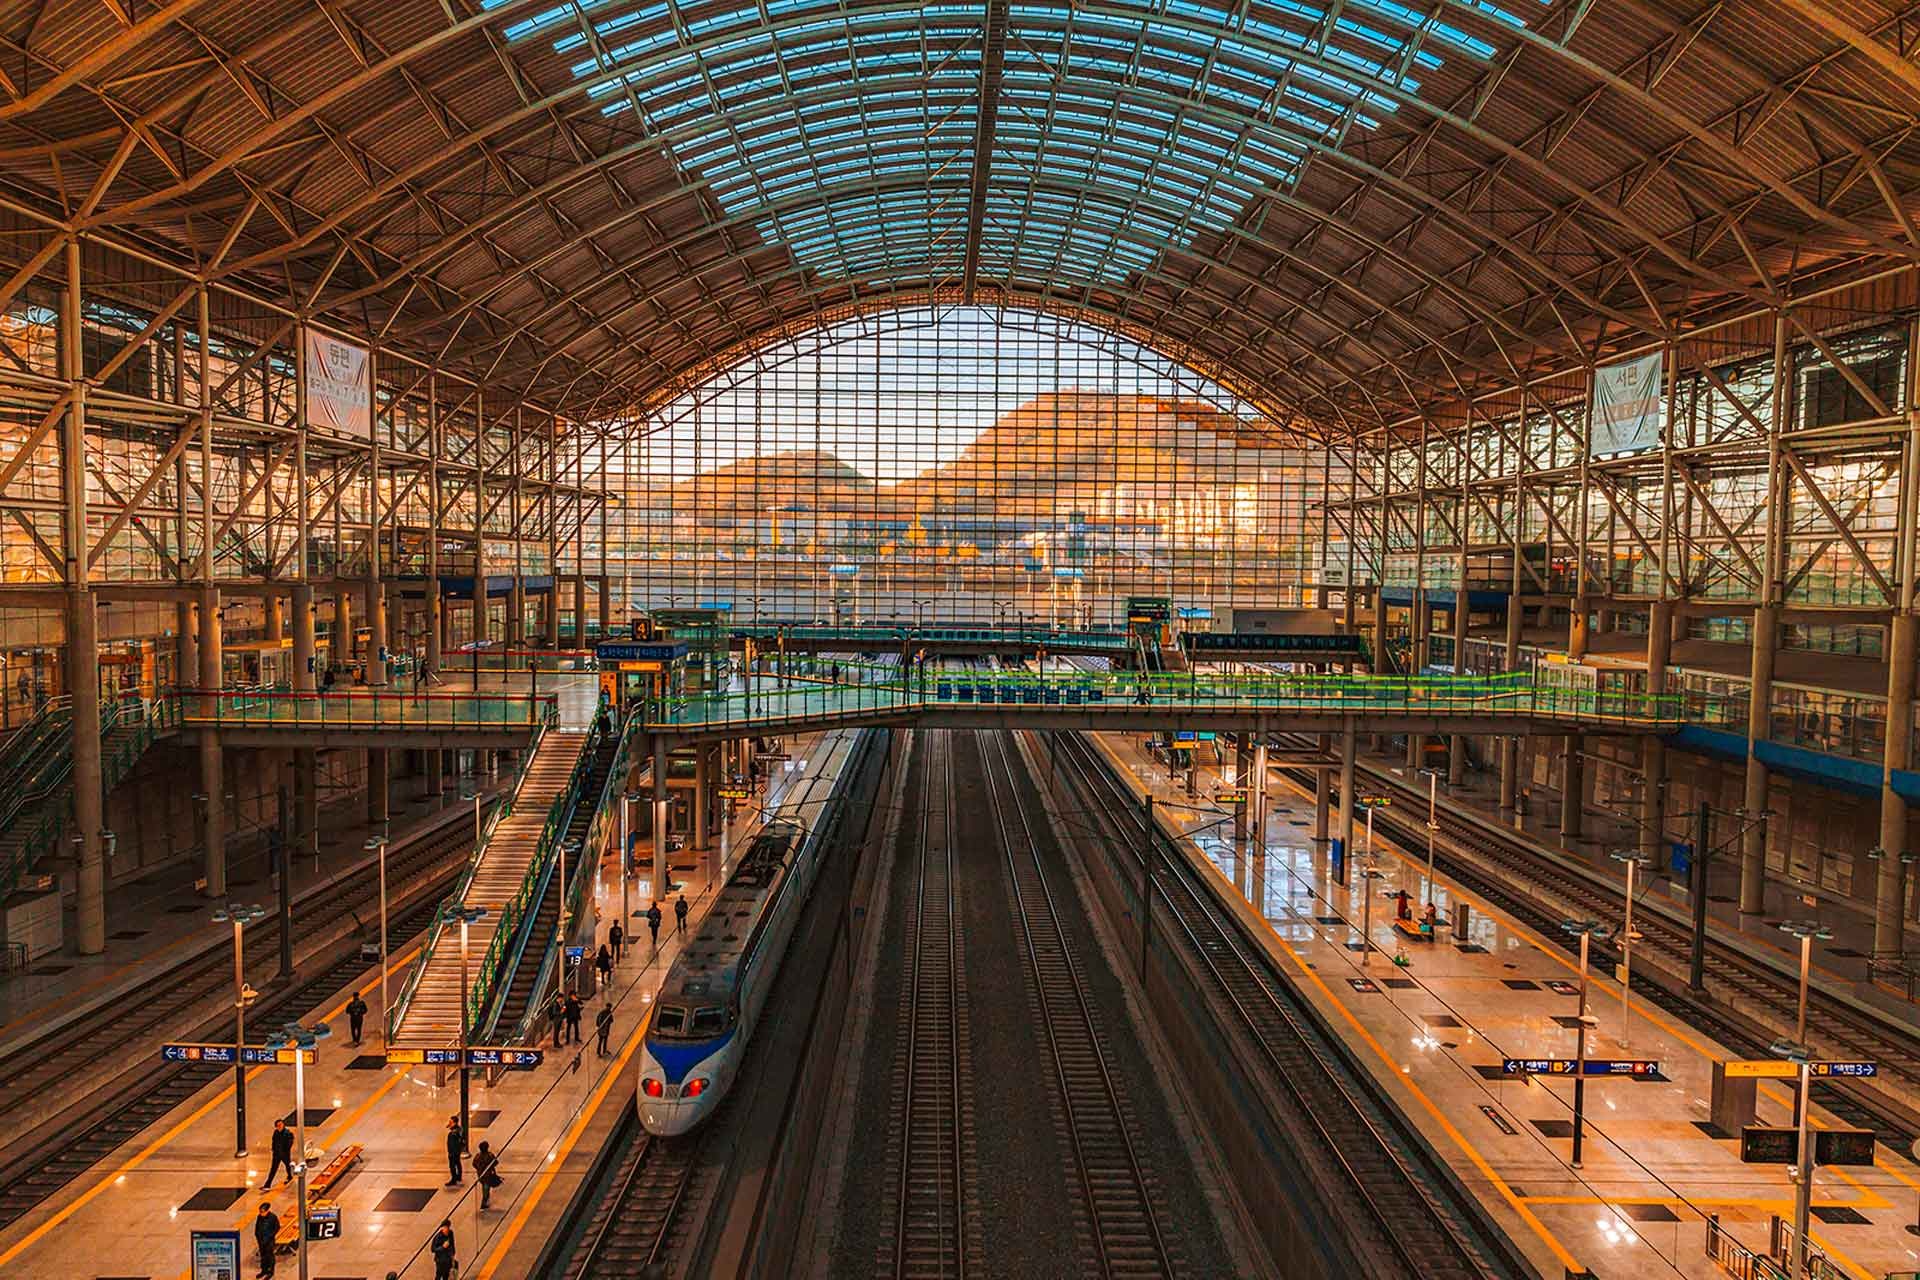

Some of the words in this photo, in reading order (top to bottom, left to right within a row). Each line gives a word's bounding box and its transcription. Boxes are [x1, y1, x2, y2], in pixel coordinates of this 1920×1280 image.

[1616, 364, 1638, 387] 서편
[570, 955, 581, 966] 13
[515, 1052, 522, 1063] 2
[1856, 1064, 1863, 1076] 3
[319, 1222, 336, 1238] 12
